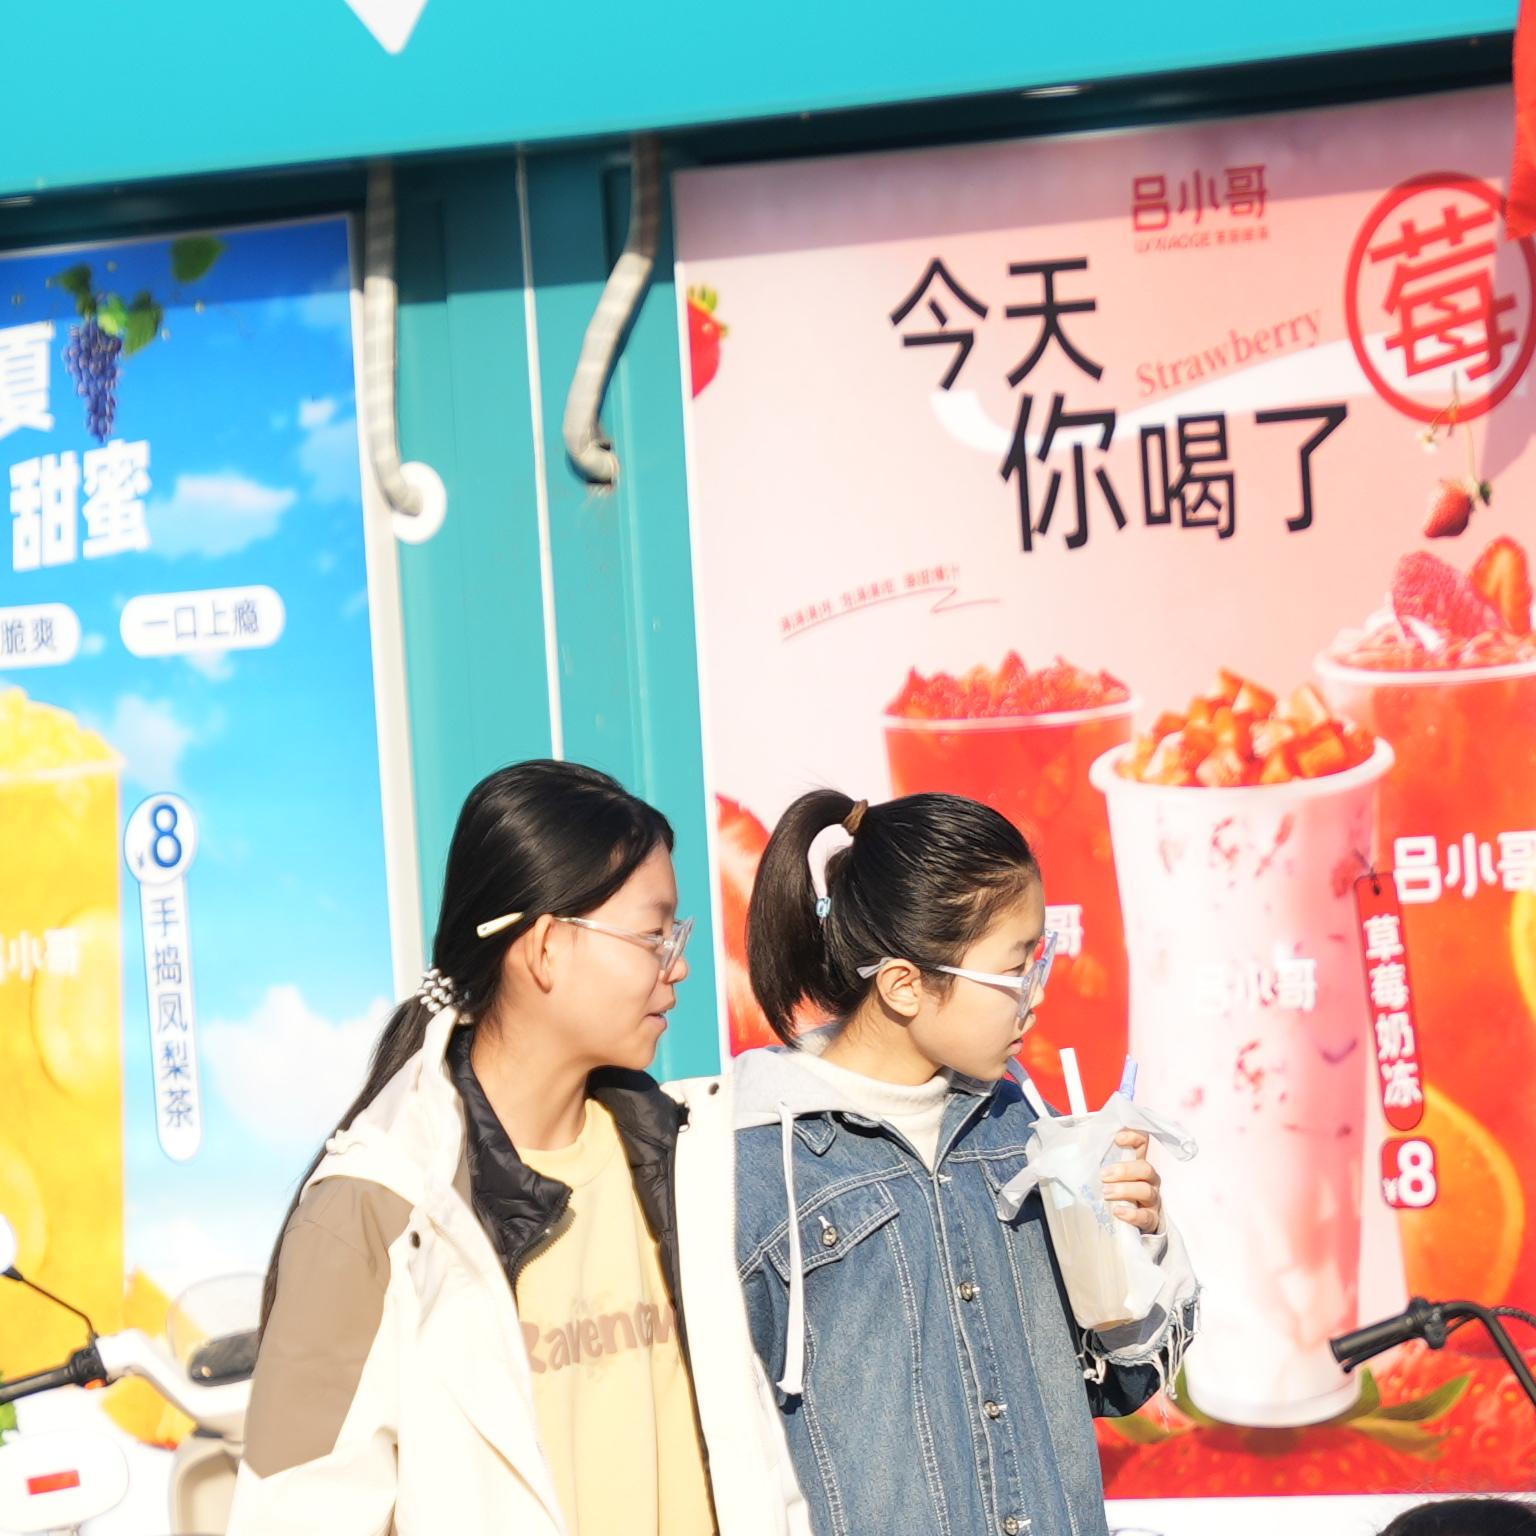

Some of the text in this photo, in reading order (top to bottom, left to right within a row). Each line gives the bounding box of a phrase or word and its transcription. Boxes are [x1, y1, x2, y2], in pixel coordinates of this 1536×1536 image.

[1133, 165, 1268, 232] 吕小哥
[888, 256, 1106, 392] 今天
[1135, 309, 1323, 399] Strawberry
[1368, 206, 1519, 385] 莓
[999, 392, 1350, 552] 你喝了
[141, 596, 261, 643] 一口上瘾
[146, 895, 194, 1129] 手捣凤梨茶
[1363, 913, 1423, 1107] 草莓奶冻
